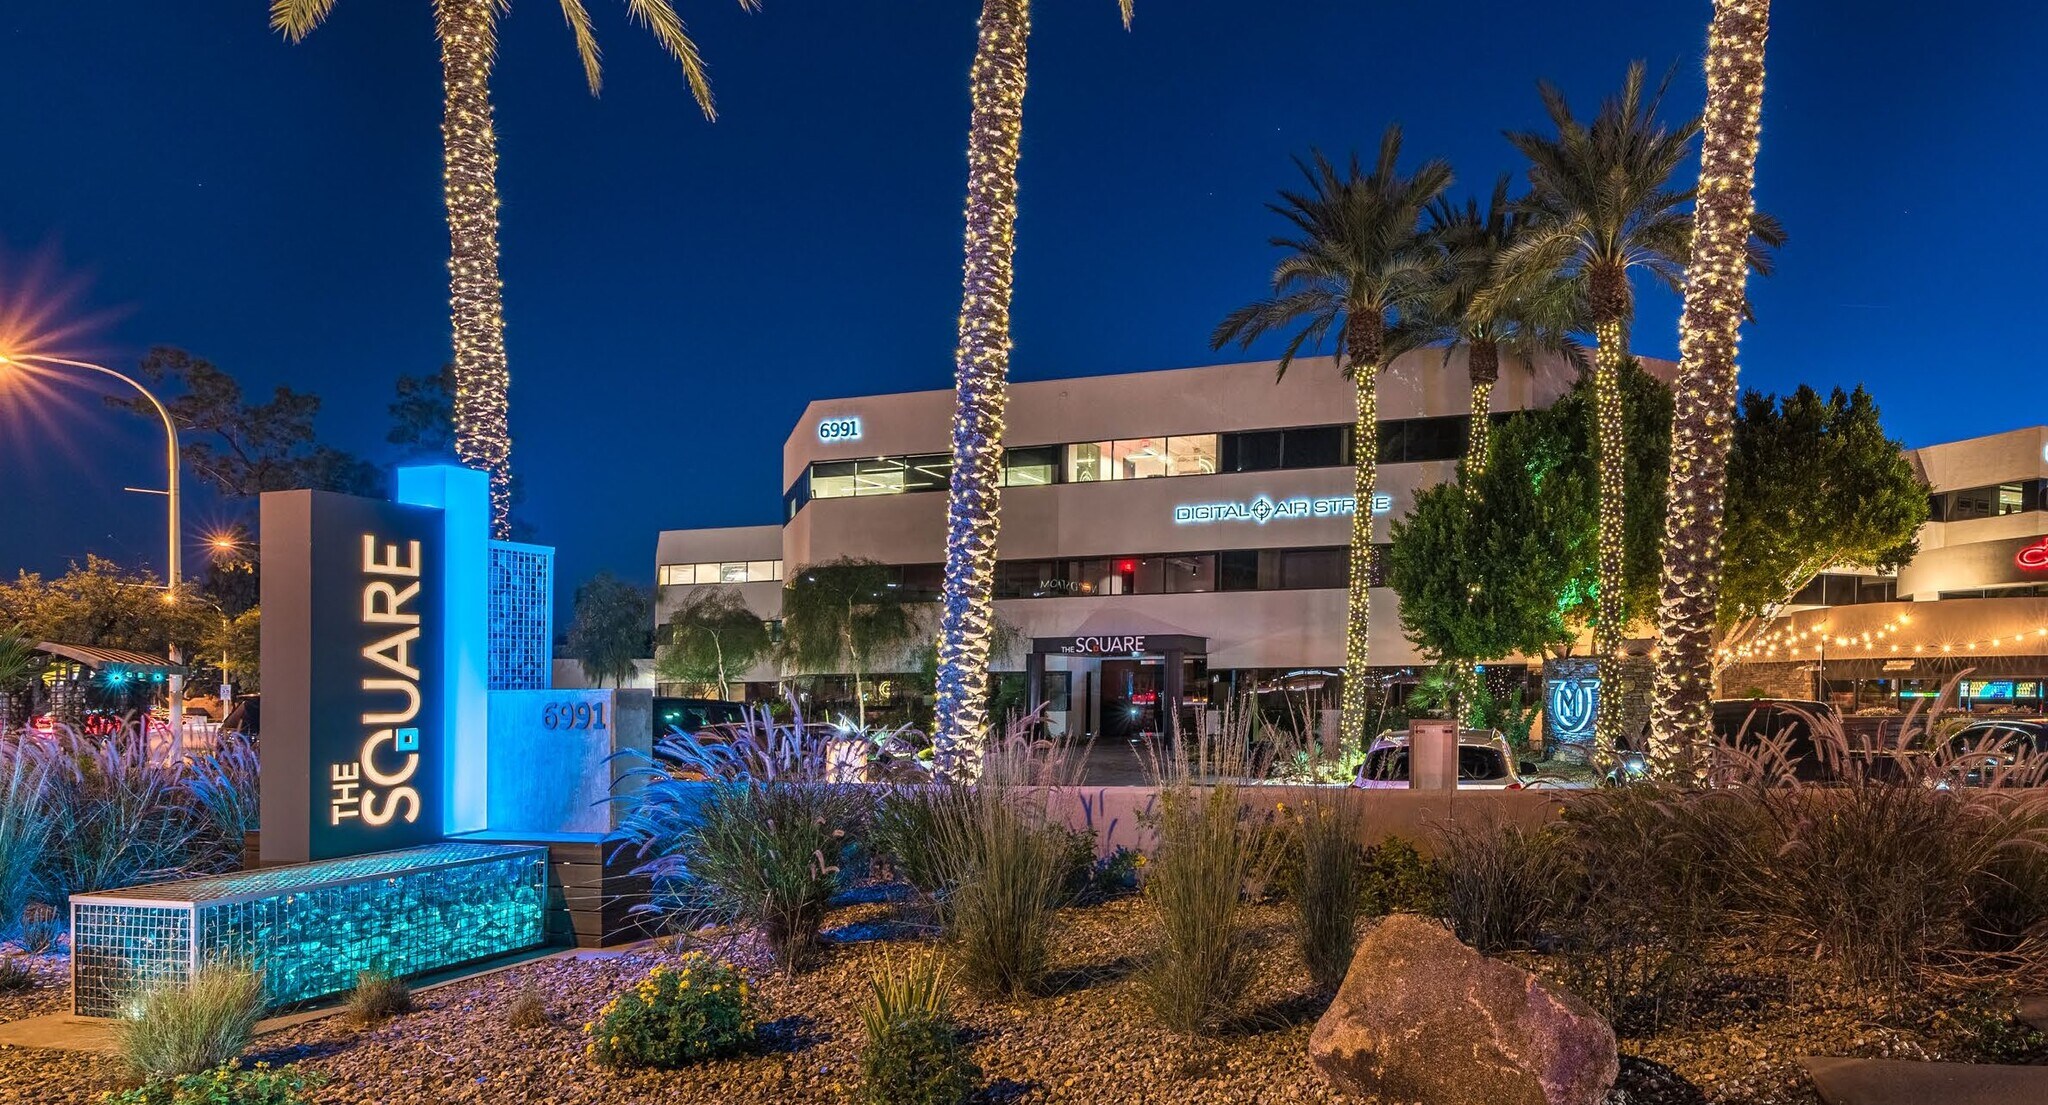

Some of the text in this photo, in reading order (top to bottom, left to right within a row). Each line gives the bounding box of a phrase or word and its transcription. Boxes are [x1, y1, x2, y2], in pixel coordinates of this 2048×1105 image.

[820, 420, 858, 438] 6991
[1176, 497, 1389, 520] DIGITAL AIR STRE
[1061, 636, 1146, 654] THE SQUARE
[332, 534, 421, 827] THE SQUARE
[541, 701, 606, 730] 6991
